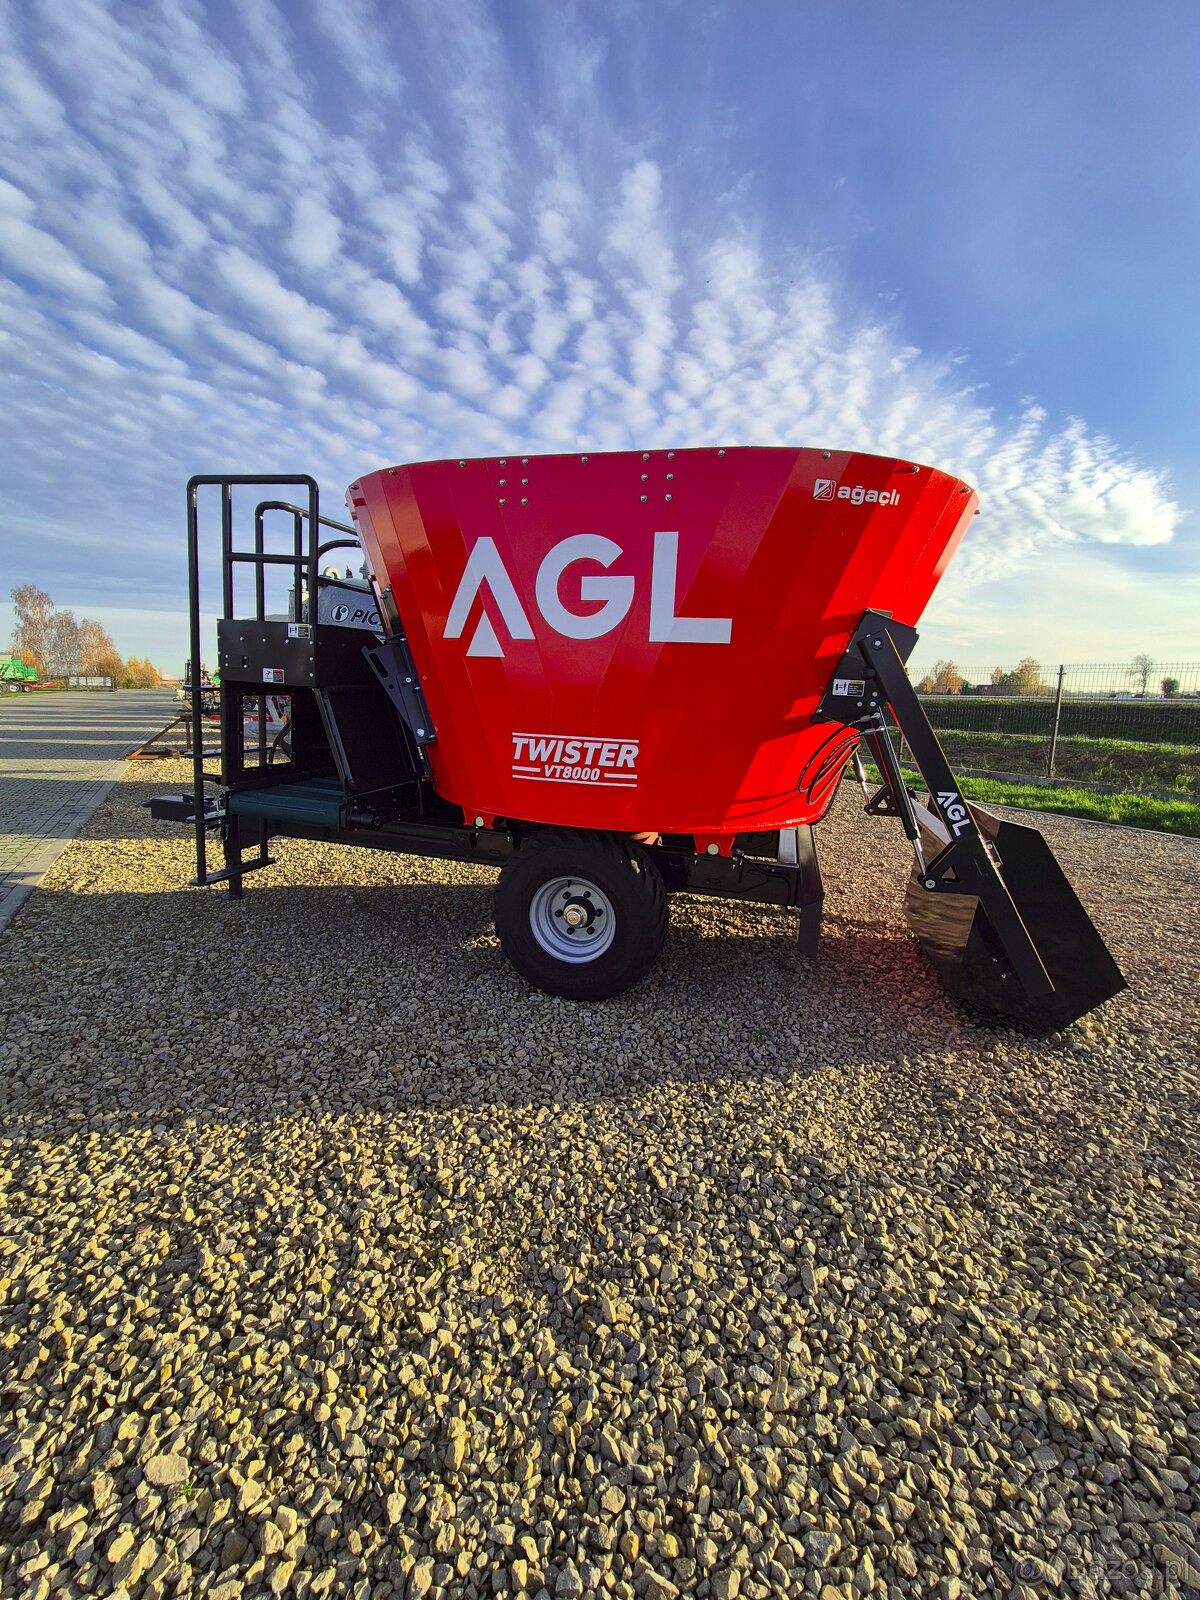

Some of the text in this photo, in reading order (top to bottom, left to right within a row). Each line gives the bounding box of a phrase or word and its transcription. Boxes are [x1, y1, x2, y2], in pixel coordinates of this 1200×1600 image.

[443, 531, 733, 658] AGL
[511, 737, 640, 768] TWISTER
[544, 765, 601, 781] VT8000
[936, 791, 971, 837] AGL
